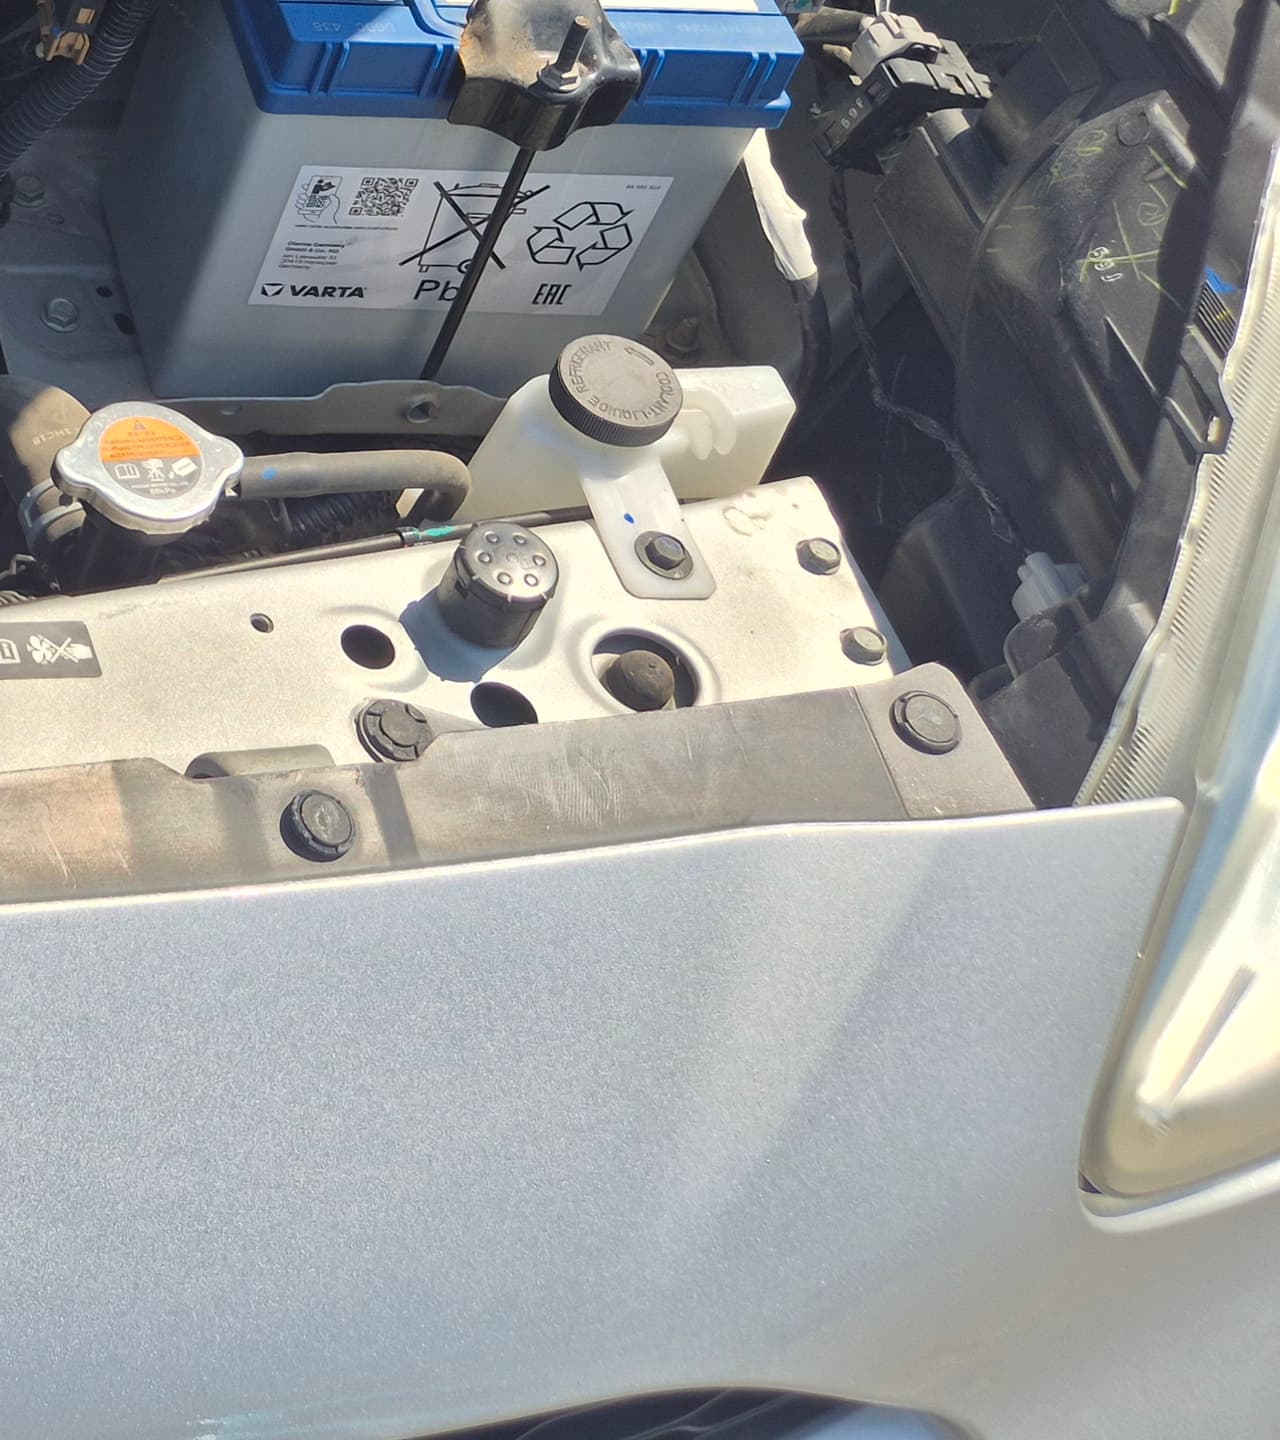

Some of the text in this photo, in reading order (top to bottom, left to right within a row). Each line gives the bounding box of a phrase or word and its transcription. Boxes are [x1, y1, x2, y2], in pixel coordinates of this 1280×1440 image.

[290, 279, 573, 305] VARTA Pb EAC
